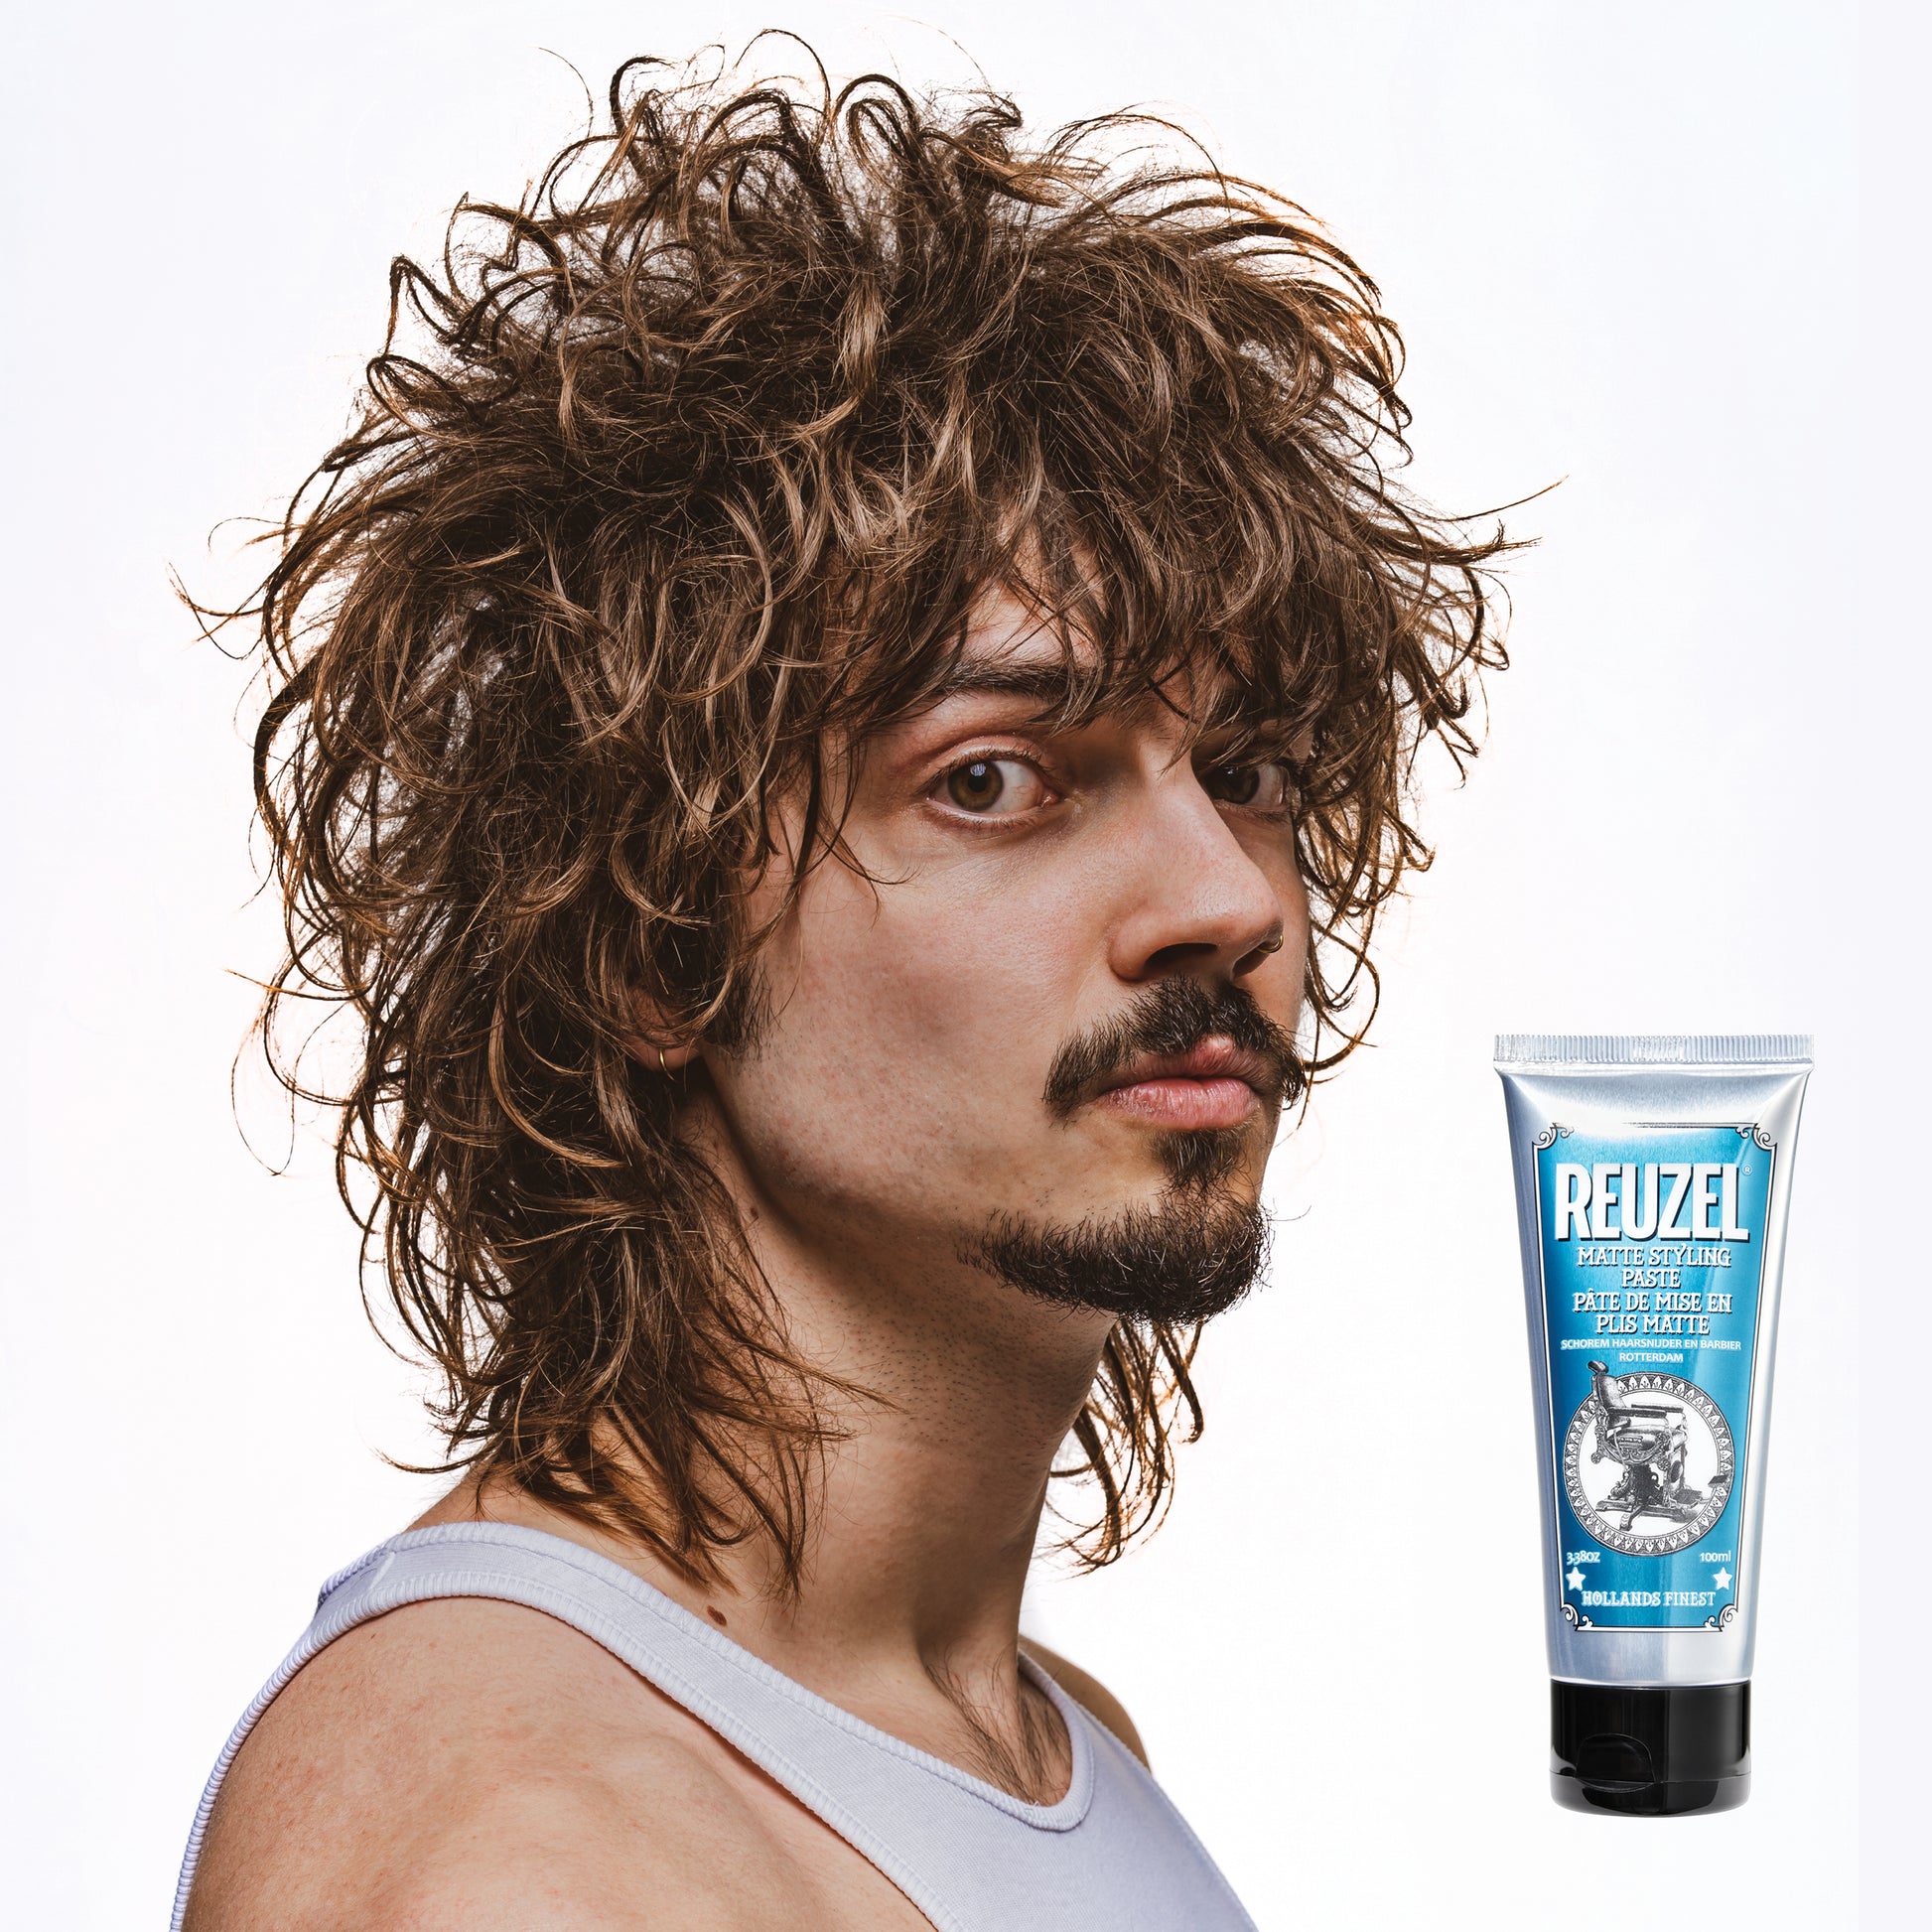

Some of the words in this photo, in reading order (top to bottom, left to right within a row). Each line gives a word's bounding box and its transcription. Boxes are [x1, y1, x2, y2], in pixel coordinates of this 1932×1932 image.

[1555, 1162, 1749, 1243] REUZEL
[1578, 1246, 1644, 1267] MATTE
[1648, 1243, 1731, 1268] STYLING
[1621, 1268, 1681, 1289] PASTE
[1573, 1288, 1620, 1312] PÂTE
[1625, 1292, 1650, 1312] DE
[1655, 1292, 1703, 1312] MISE
[1707, 1293, 1732, 1313] EN
[1595, 1313, 1638, 1334] PLIS
[1642, 1313, 1711, 1335] MATTE
[1561, 1338, 1610, 1350] SCHOREM
[1684, 1339, 1698, 1349] EN
[1700, 1339, 1741, 1350] BARBIER
[1619, 1352, 1684, 1363] ROTTERDAM
[1700, 1550, 1731, 1563] 100ml
[1582, 1590, 1661, 1607] HOLLANDS
[1663, 1590, 1717, 1606] FINEST
